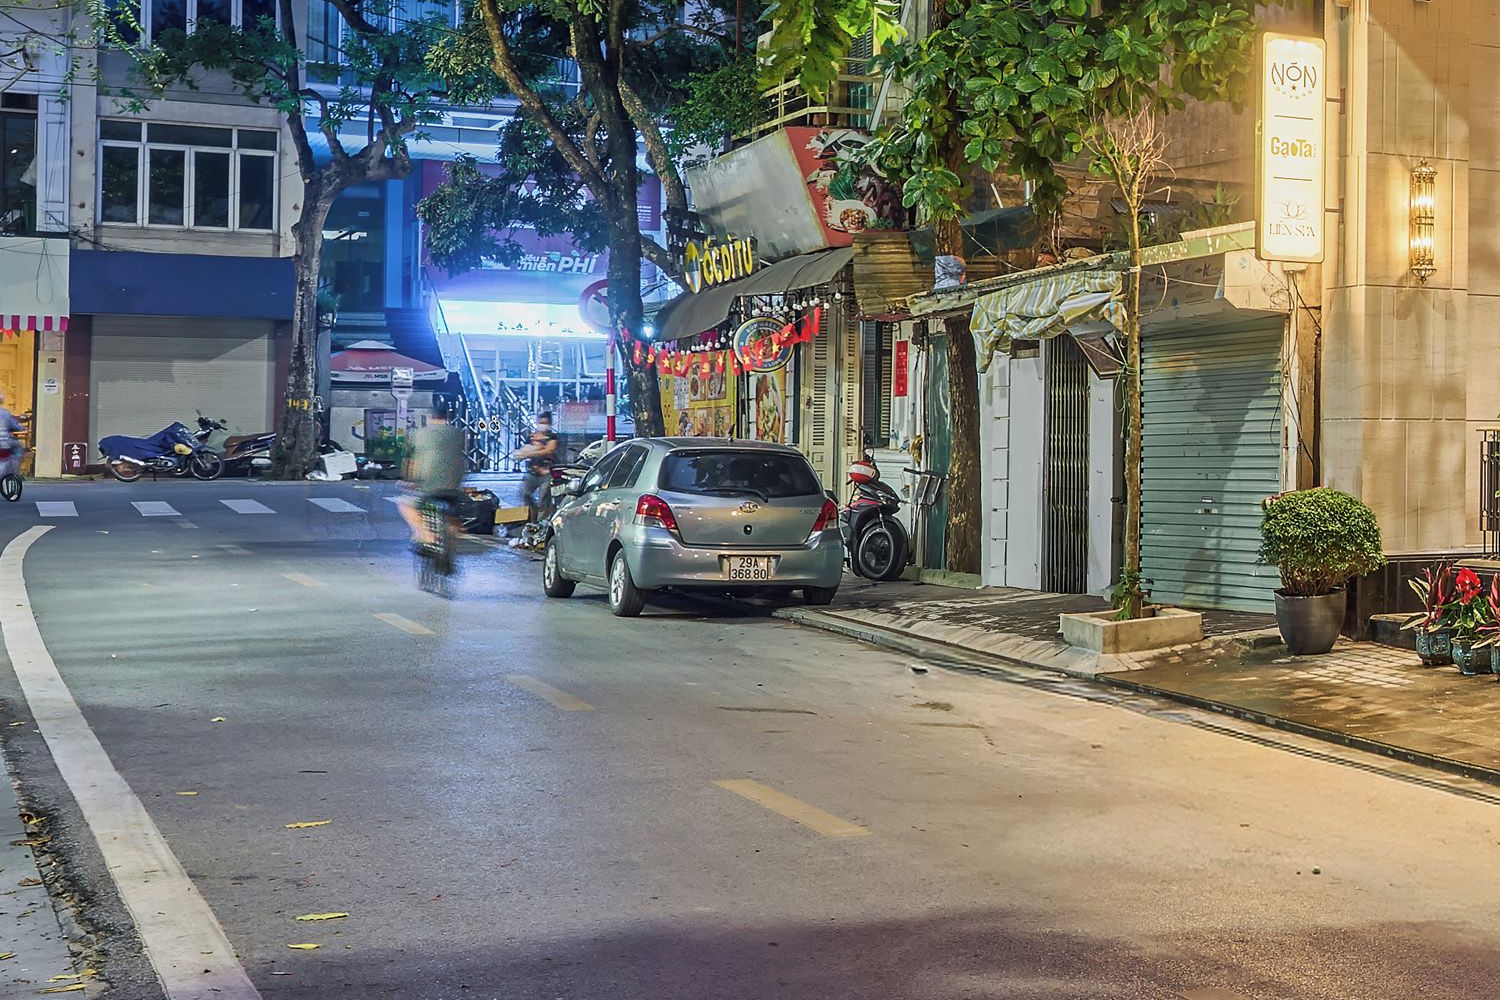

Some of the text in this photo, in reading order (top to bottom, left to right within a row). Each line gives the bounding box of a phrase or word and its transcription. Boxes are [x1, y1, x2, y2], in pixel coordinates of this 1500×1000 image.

[557, 254, 600, 273] PHÍ
[739, 558, 759, 568] 29A
[731, 568, 767, 580] 368.80
